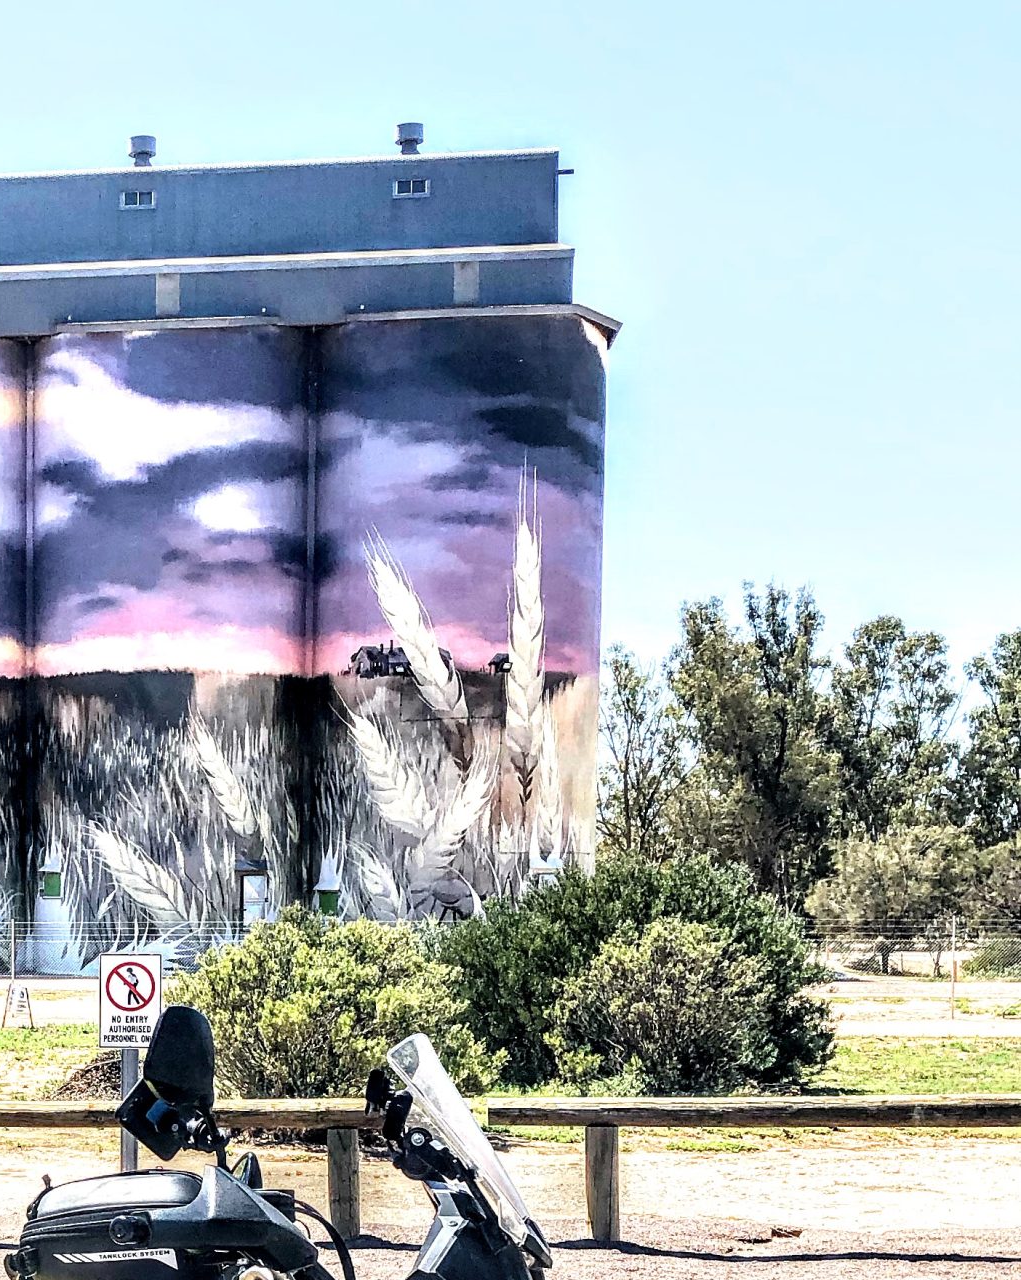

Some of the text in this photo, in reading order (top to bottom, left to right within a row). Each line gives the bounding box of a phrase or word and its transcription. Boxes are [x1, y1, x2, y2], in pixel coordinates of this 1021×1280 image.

[111, 1015, 148, 1023] NO ENTRY
[109, 1025, 151, 1033] AUTHORISED
[141, 1035, 152, 1043] ON
